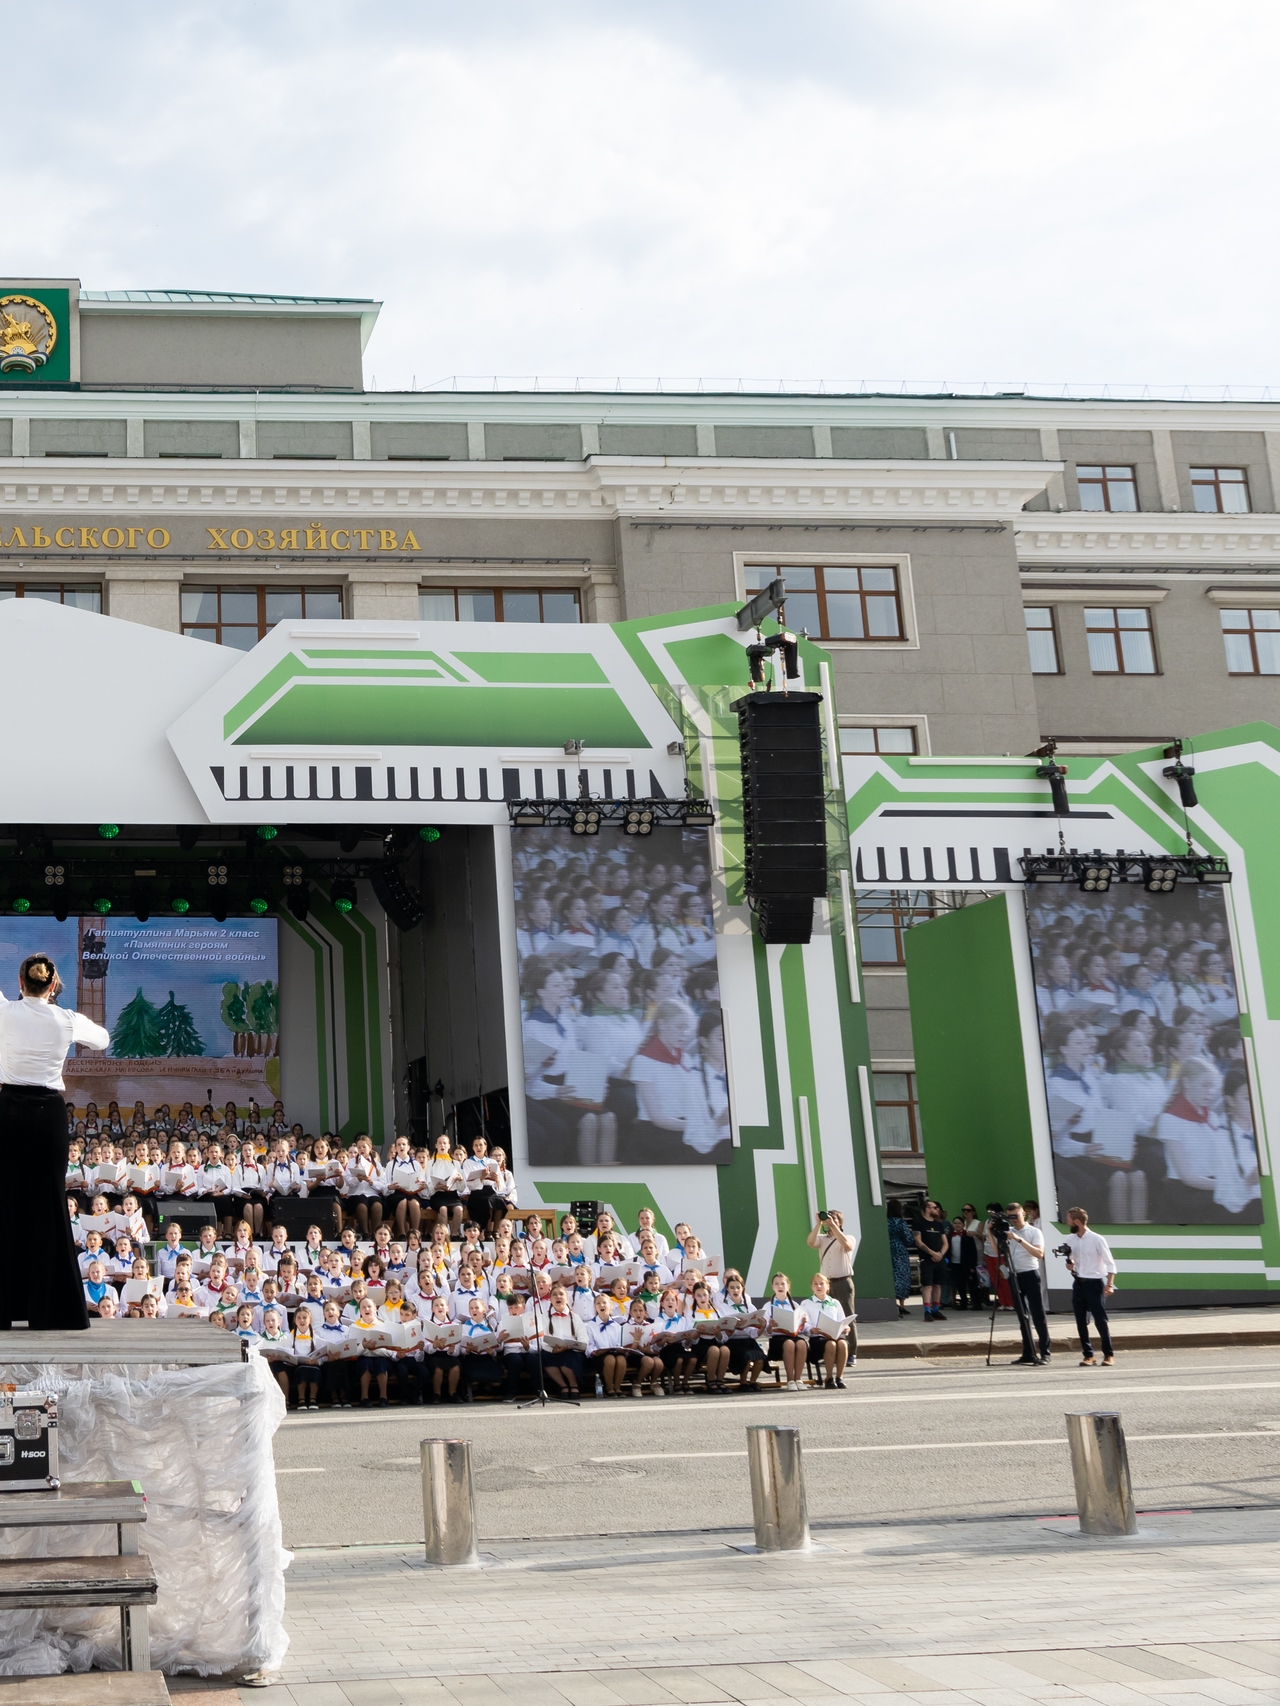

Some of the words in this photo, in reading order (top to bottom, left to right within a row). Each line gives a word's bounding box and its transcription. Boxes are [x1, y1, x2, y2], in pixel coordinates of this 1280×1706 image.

[206, 522, 422, 551] ХОЗЯЙСТВА
[88, 928, 172, 938] Гатиятуллина
[174, 928, 218, 938] Марьям
[220, 929, 227, 938] 2
[228, 930, 260, 938] класс
[123, 940, 187, 949] «Памятник
[188, 942, 229, 950] героям
[82, 951, 129, 960] Великой
[131, 952, 222, 961] Отечественной
[224, 952, 266, 961] войны»
